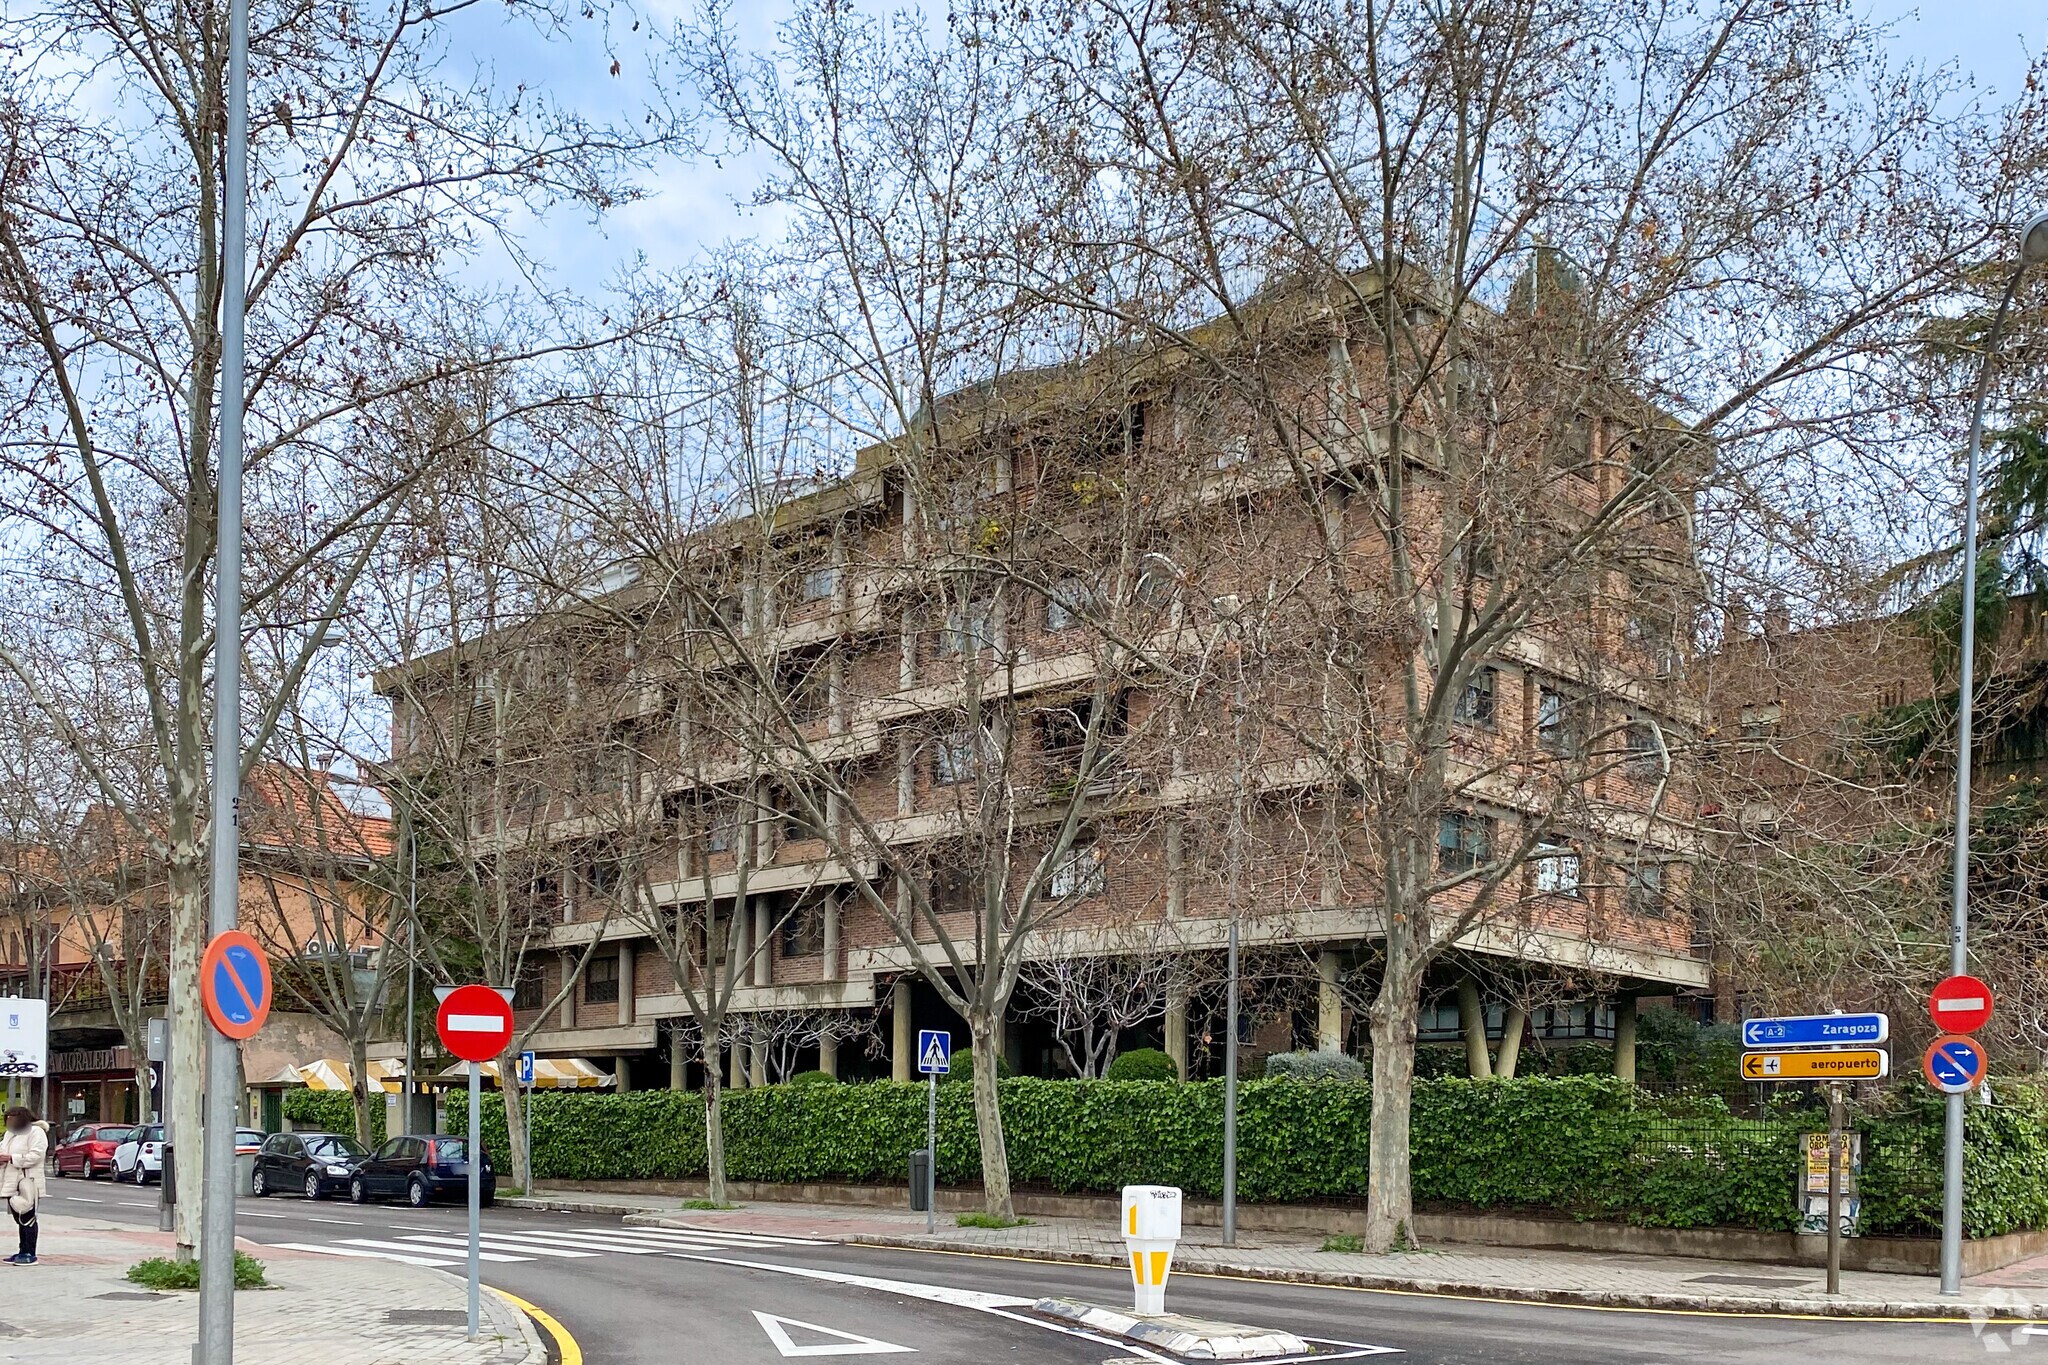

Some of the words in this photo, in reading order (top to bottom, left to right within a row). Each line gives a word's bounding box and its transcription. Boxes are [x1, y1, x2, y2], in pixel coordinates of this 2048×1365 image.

[1767, 1027, 1783, 1036] A-2
[1822, 1024, 1877, 1035] Zaragoza
[523, 1056, 530, 1079] P
[1811, 1059, 1878, 1070] aeropuerto
